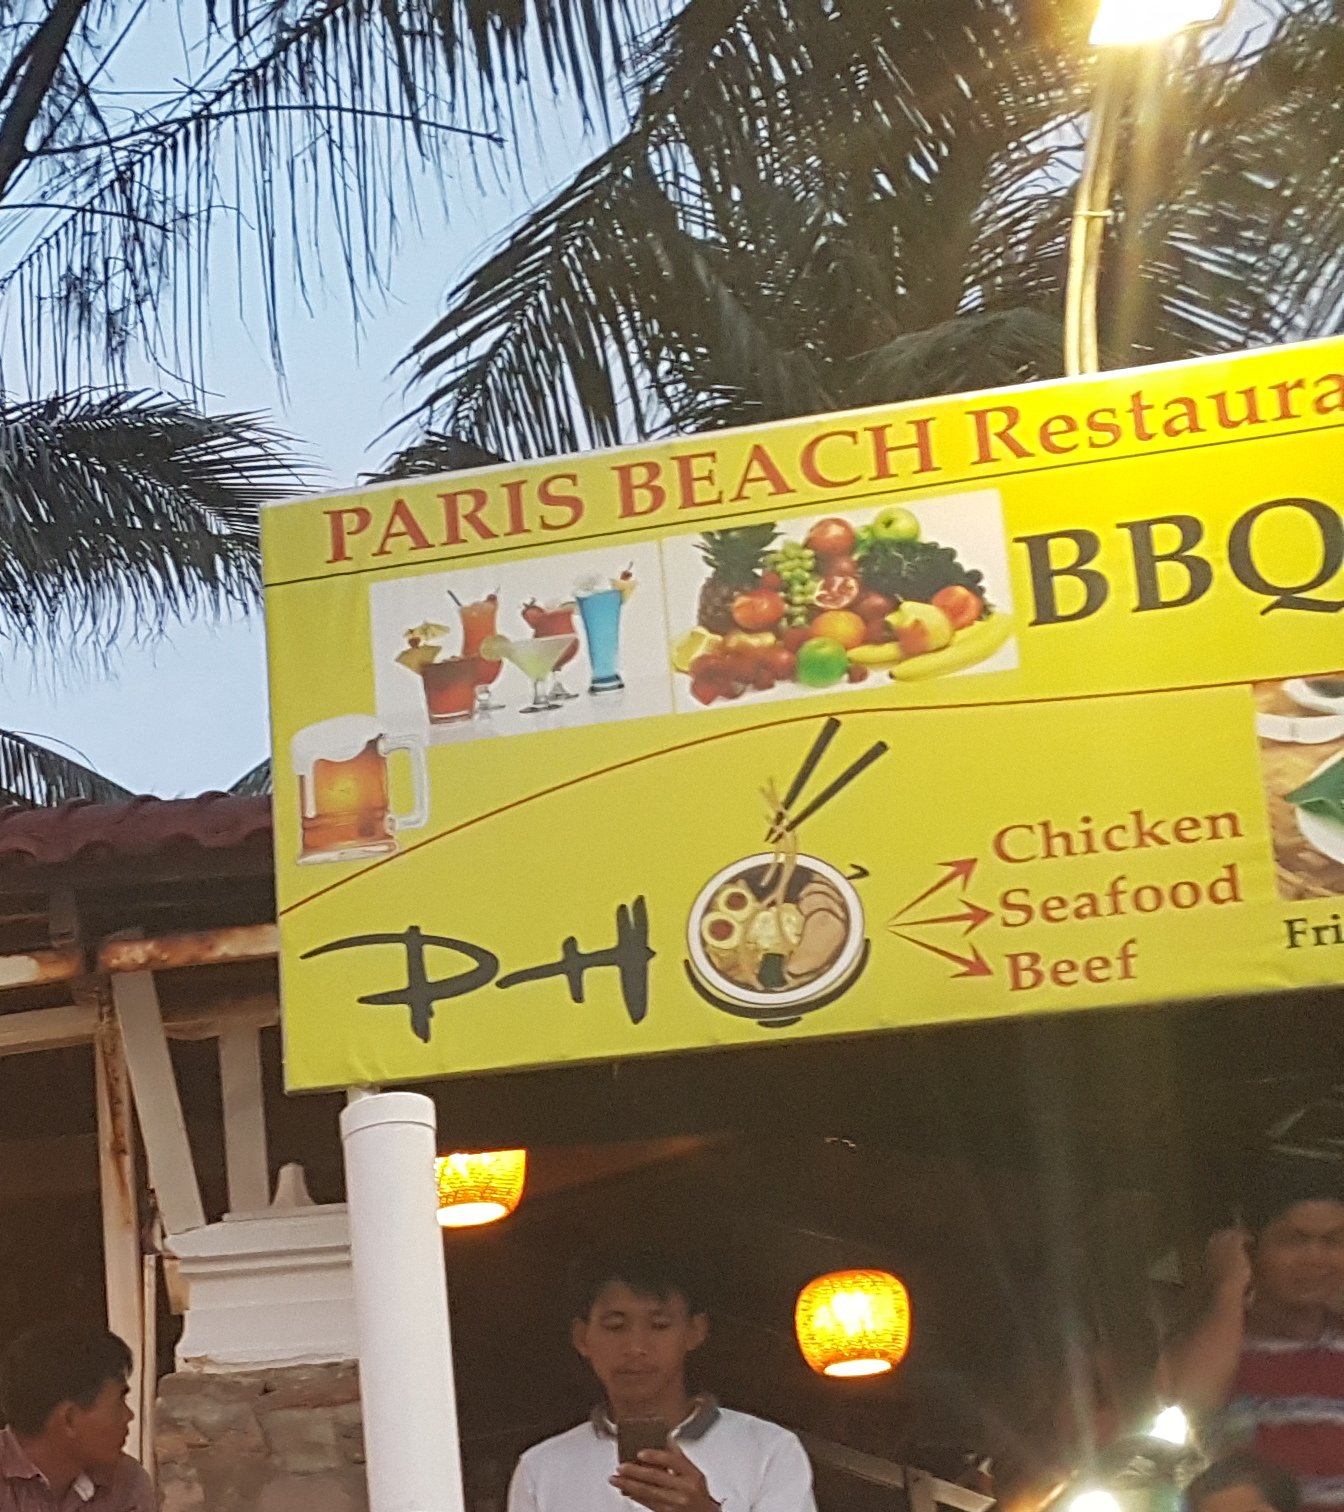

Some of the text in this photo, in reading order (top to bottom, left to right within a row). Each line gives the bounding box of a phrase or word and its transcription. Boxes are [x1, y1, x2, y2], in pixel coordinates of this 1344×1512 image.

[323, 472, 586, 565] PARIS
[611, 416, 940, 519] BEACH
[1012, 496, 1344, 628] BBQ
[992, 808, 1245, 865] Chicken
[999, 862, 1245, 929] Seafood
[1004, 937, 1138, 992] Beef
